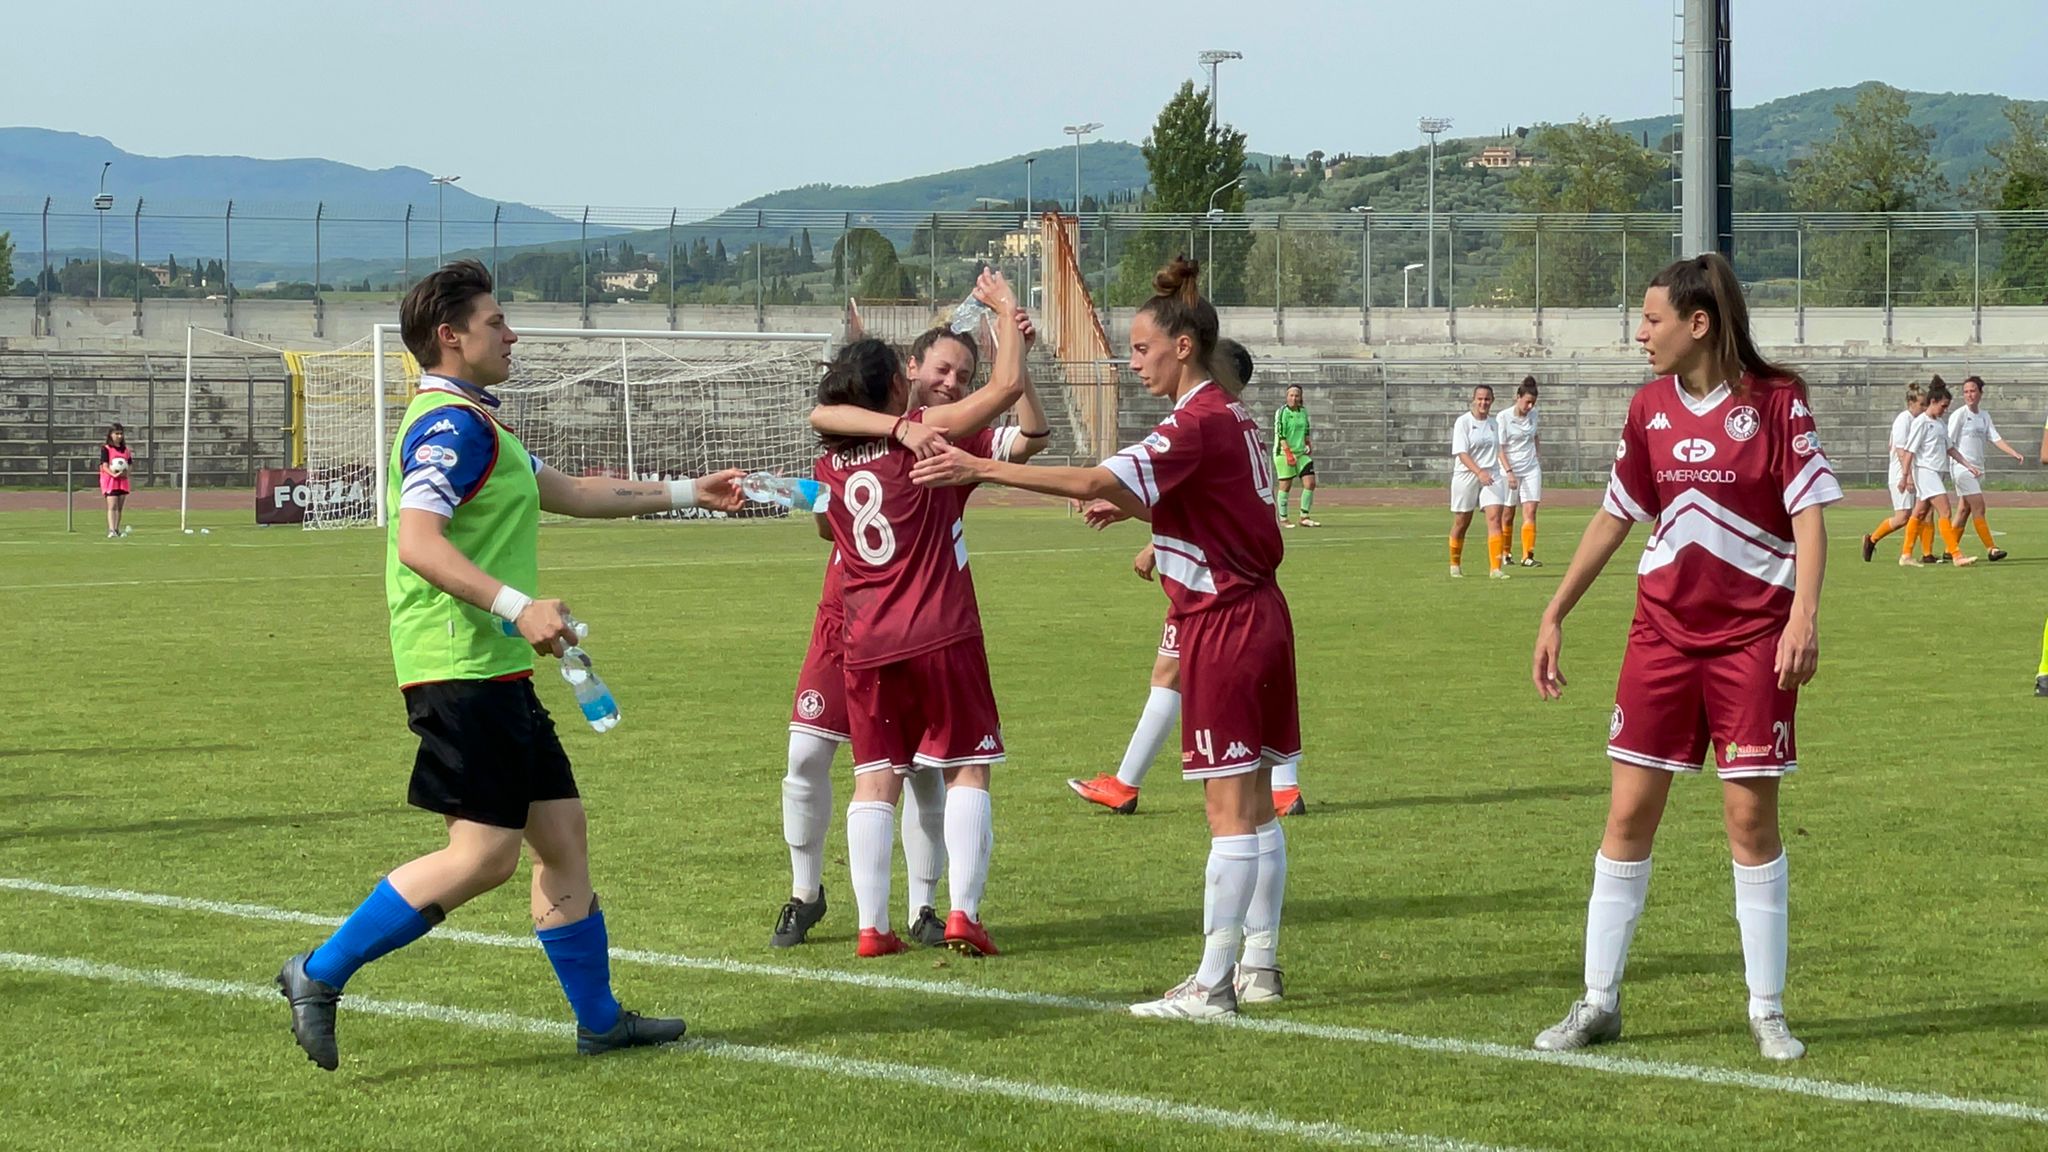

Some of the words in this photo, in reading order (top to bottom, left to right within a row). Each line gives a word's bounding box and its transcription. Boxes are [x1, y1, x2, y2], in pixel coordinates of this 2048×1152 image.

[274, 481, 364, 509] FORZA
[844, 470, 896, 566] 8
[1195, 729, 1215, 765] 4
